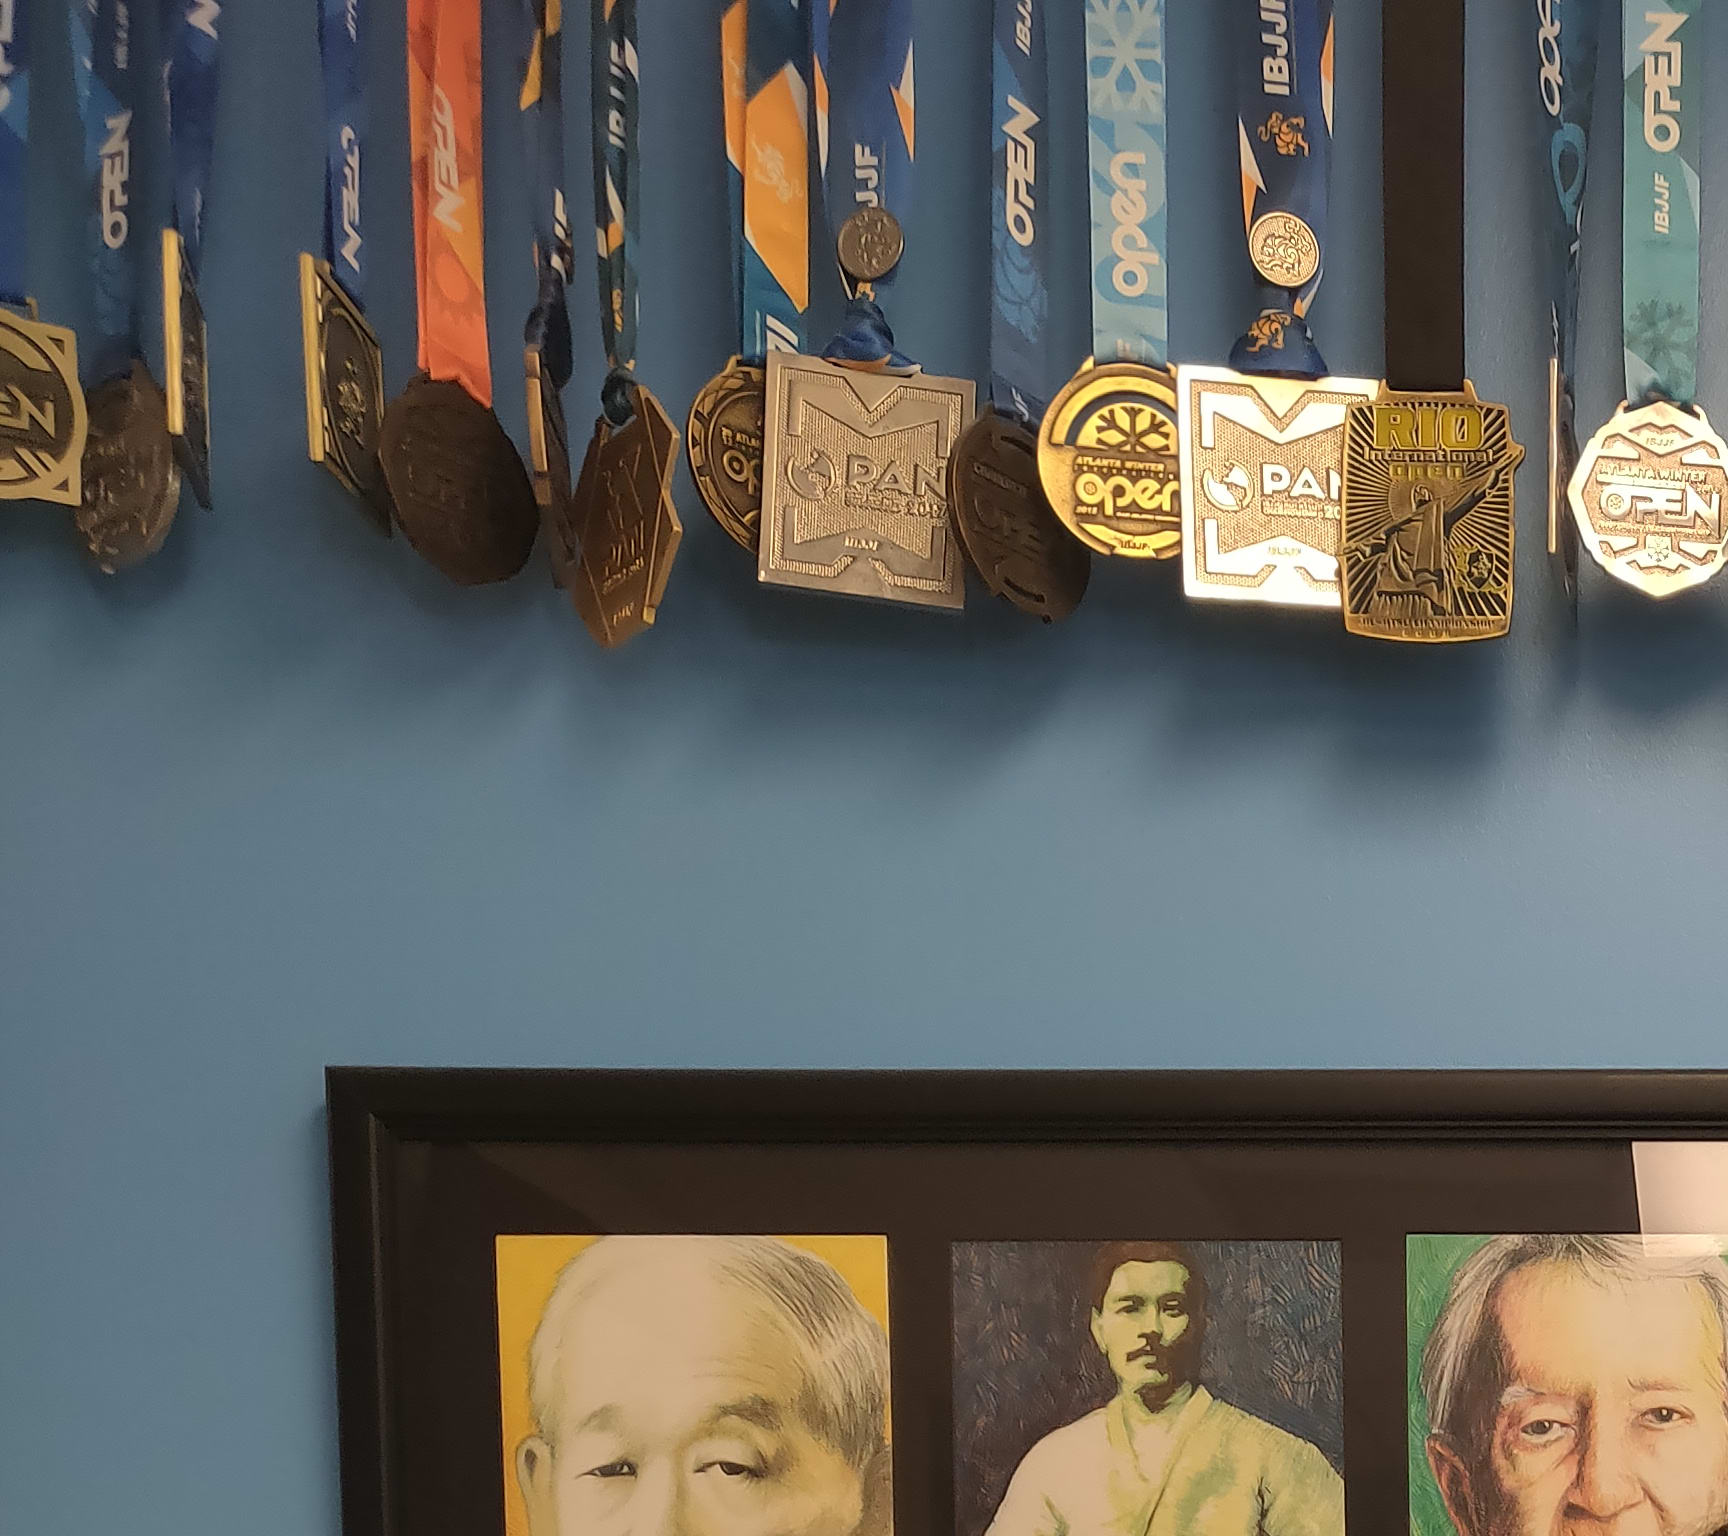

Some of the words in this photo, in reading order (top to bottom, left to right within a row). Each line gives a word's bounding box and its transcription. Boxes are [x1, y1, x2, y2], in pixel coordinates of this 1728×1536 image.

[1639, 11, 1690, 153] OPEN
[99, 109, 133, 249] OPEN
[1001, 95, 1041, 247] OPEN
[1654, 173, 1671, 234] IBJJF
[1373, 407, 1483, 450] RIO
[847, 455, 947, 500] PAN
[1599, 484, 1722, 540] OPEN
